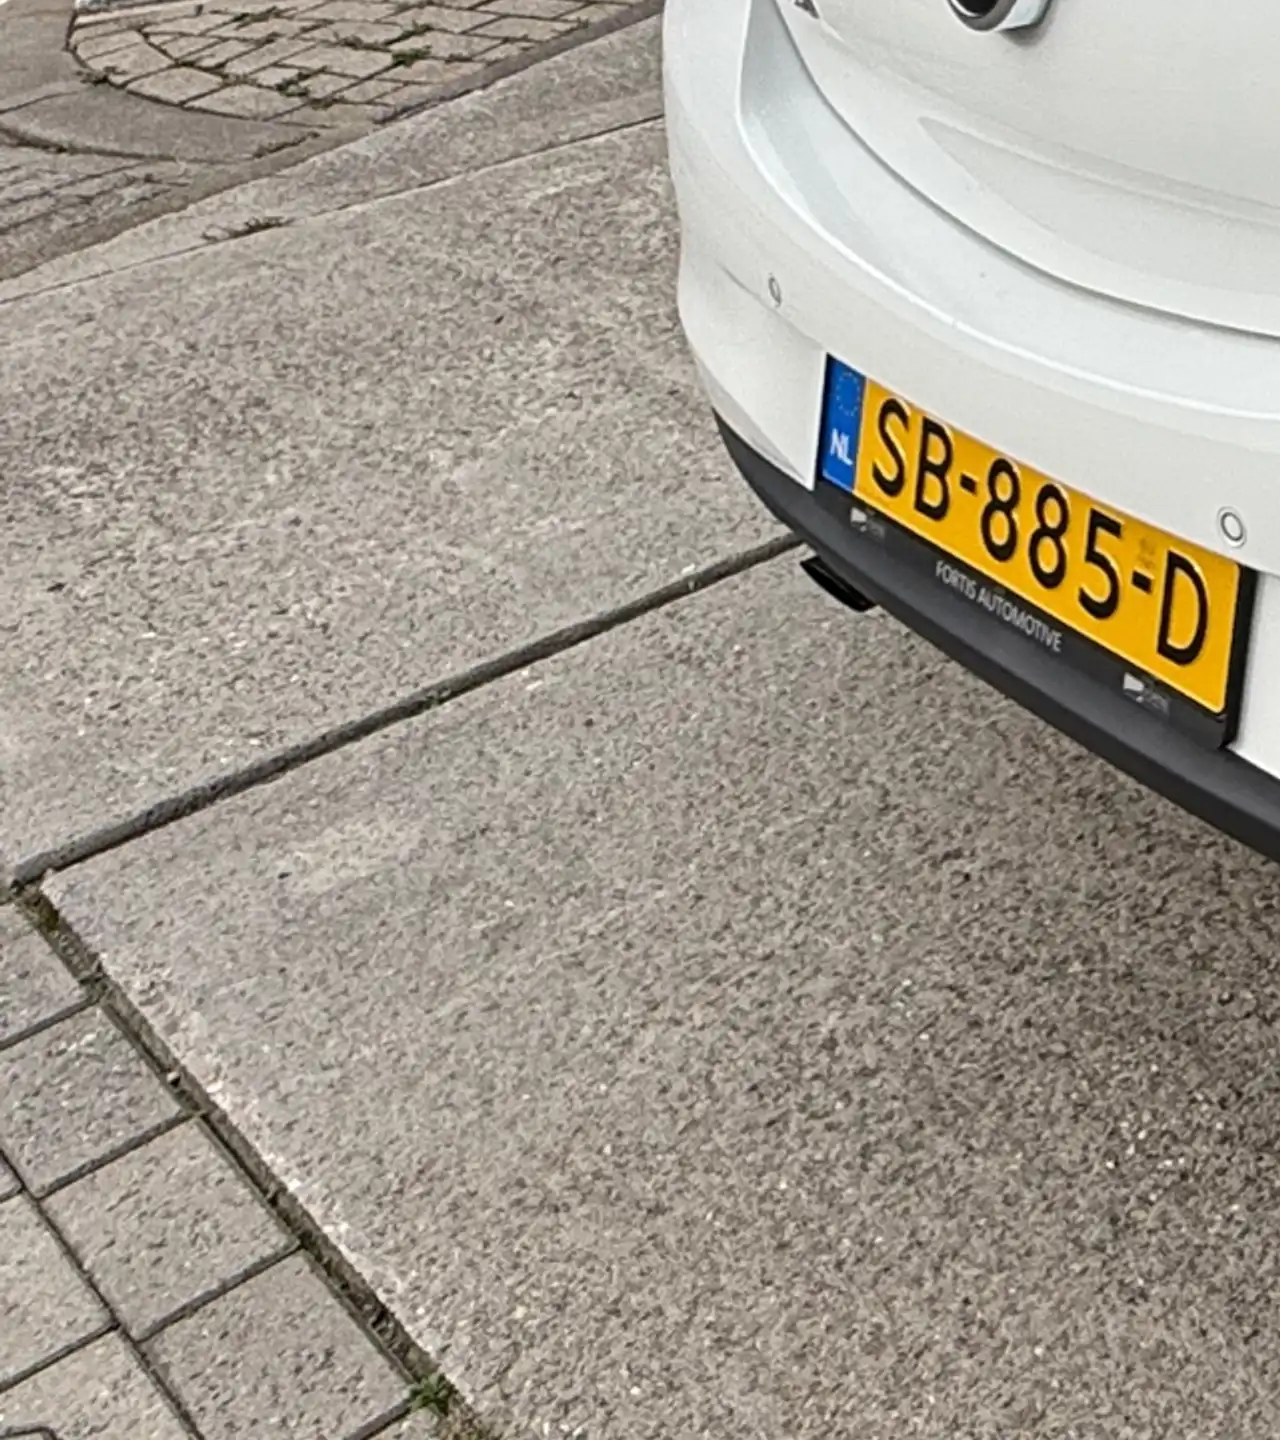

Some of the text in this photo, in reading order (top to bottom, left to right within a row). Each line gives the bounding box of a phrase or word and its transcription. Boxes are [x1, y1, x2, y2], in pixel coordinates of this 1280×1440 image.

[830, 427, 854, 466] NL
[871, 398, 1210, 667] SB-885-D
[935, 560, 1063, 653] FORTIS AUTOMOTIVE
